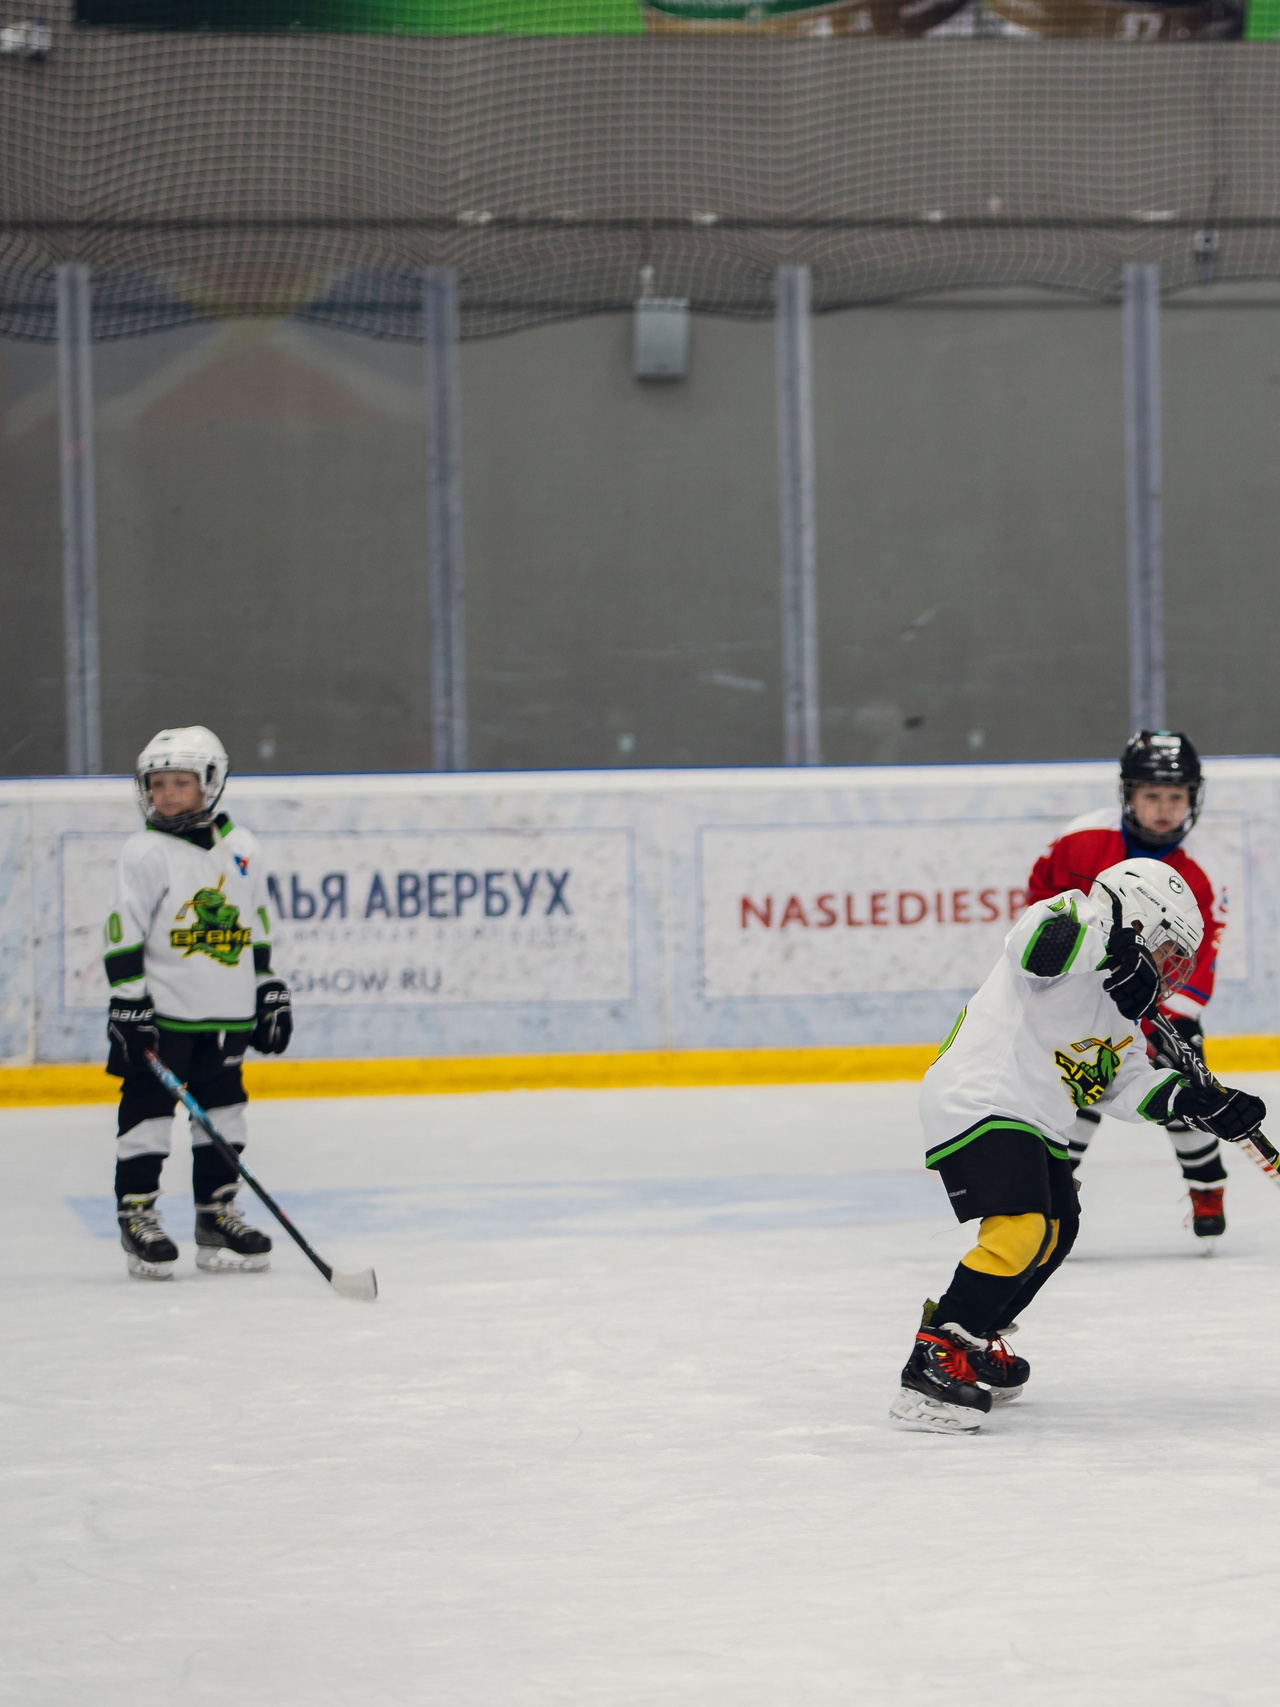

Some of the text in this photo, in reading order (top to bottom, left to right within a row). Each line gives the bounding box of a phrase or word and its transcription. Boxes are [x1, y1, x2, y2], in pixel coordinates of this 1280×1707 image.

[266, 868, 573, 920] ЛЬЯ АВЕРБУХ
[110, 1007, 153, 1023] BAUE
